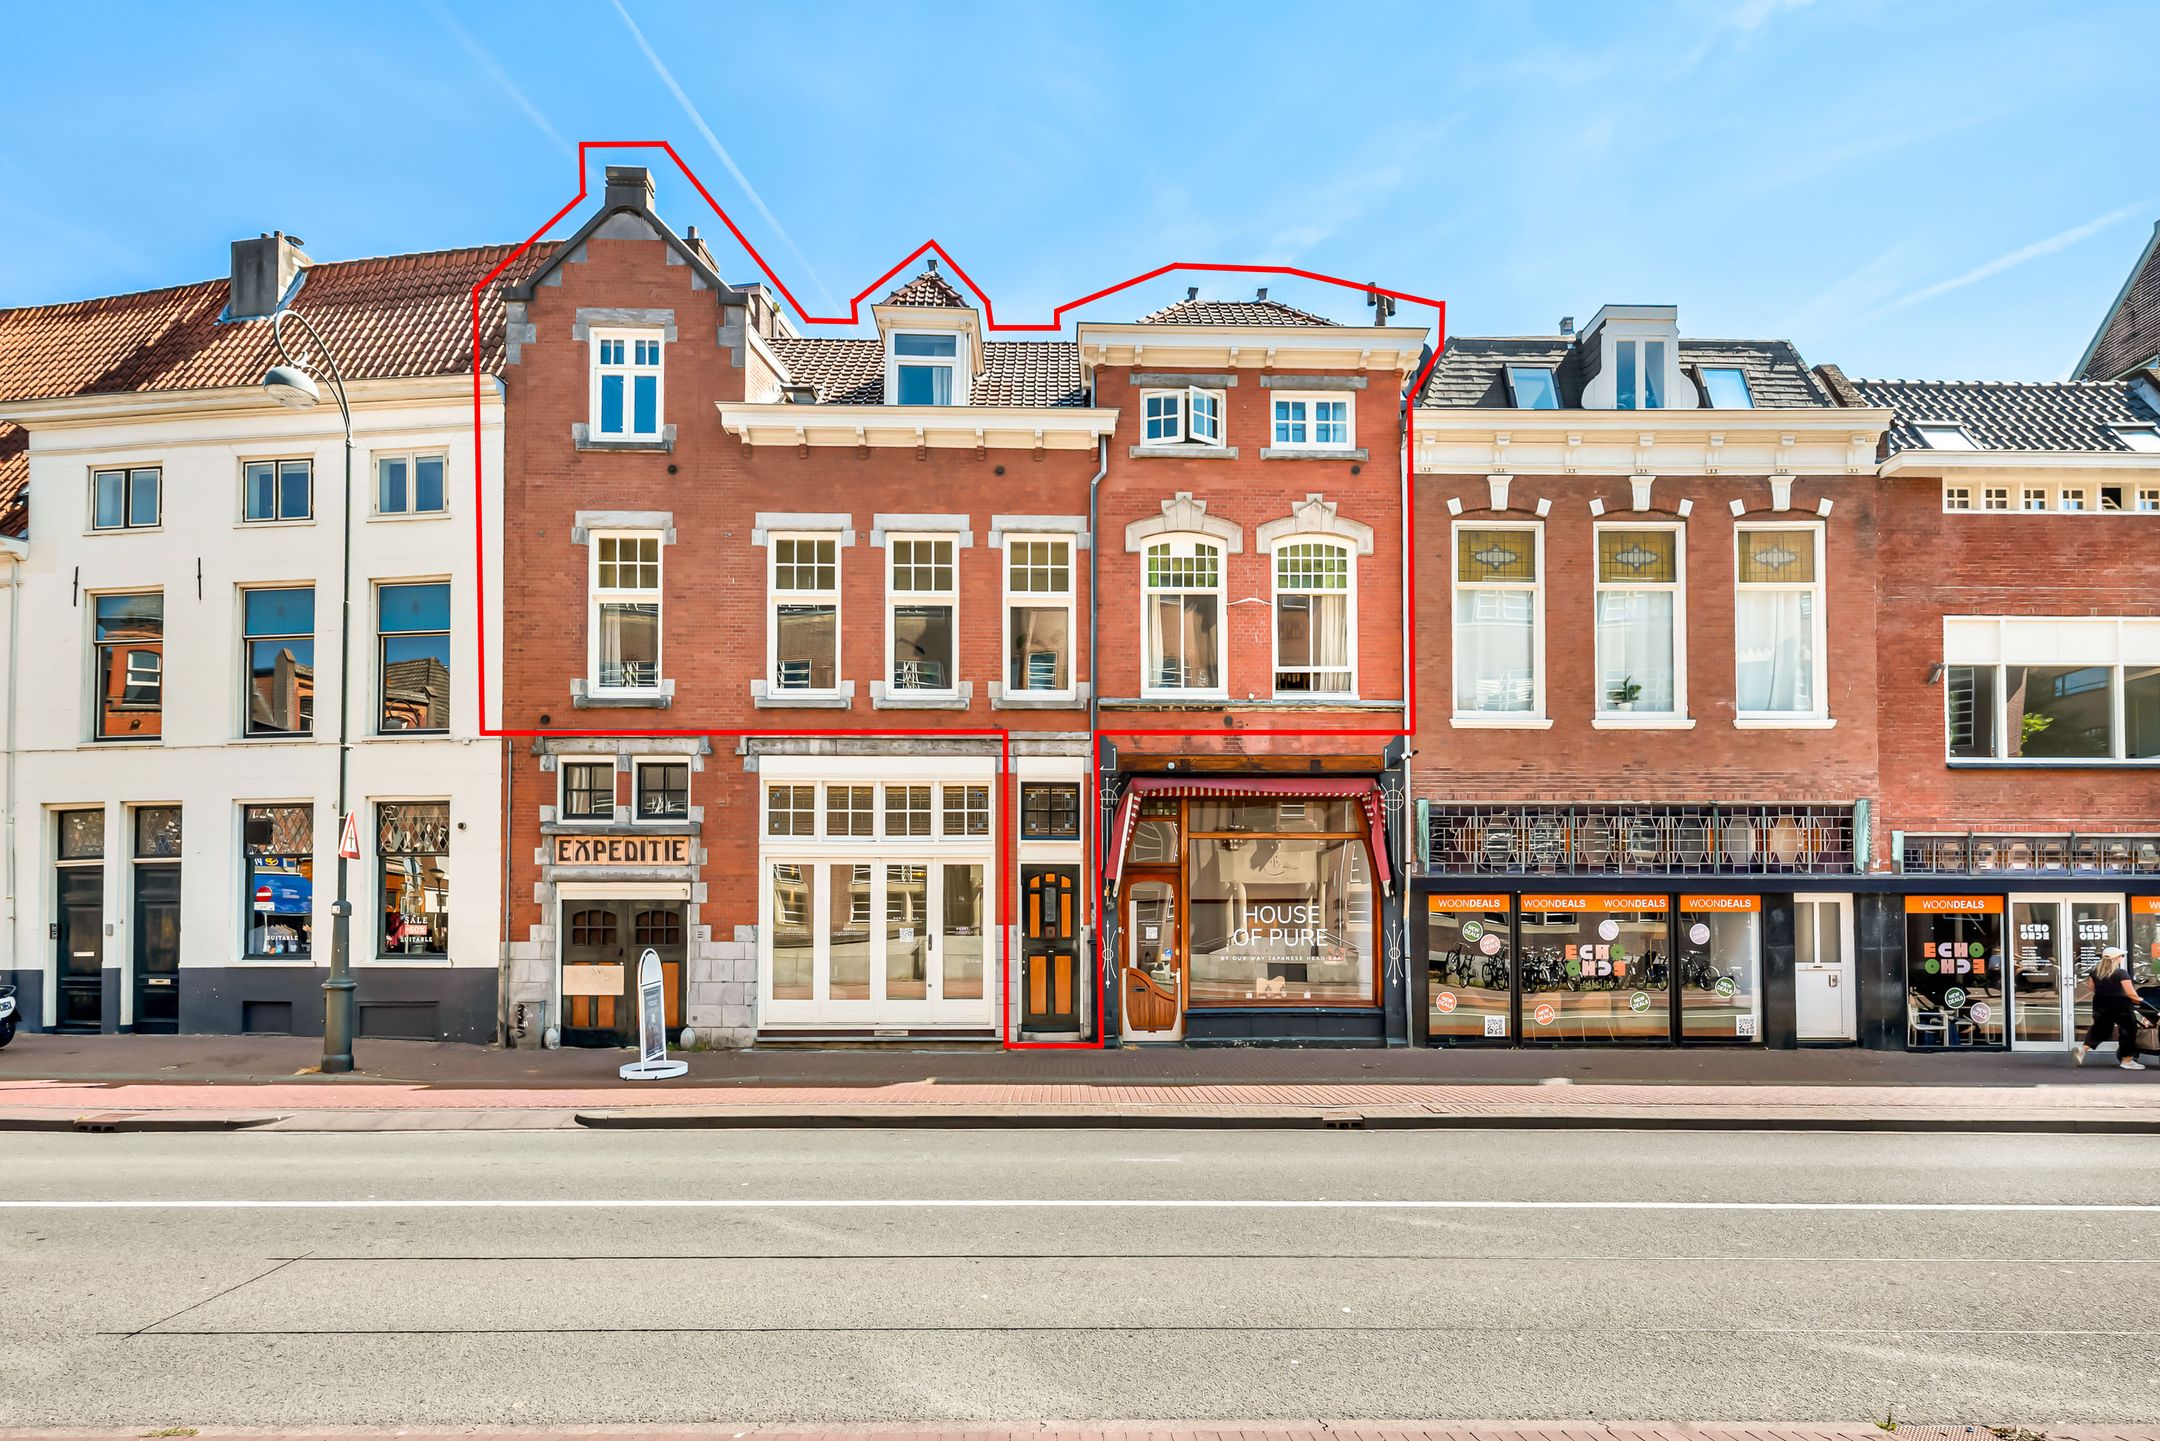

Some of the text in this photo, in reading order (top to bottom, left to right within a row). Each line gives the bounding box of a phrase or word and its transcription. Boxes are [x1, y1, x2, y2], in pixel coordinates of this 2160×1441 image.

[558, 839, 686, 862] EXPEDITIE
[1438, 899, 1501, 908] WOONDEALS
[1524, 899, 1587, 908] WOONDEALS
[1603, 899, 1666, 908] WOONDEALS
[1689, 899, 1752, 908] WOONDEALS
[1922, 899, 1985, 909] WOONDEALS
[1242, 905, 1321, 924] HOUSE
[404, 916, 429, 924] SALE
[2020, 923, 2050, 932] ECHO
[2079, 924, 2109, 933] ECHO
[1233, 928, 1328, 947] OF PURE
[1464, 929, 1480, 939] DEALS
[1564, 943, 1626, 960] ECHO
[1923, 941, 1985, 958] ECHO
[1717, 984, 1733, 995] DEALS
[1438, 999, 1454, 1010] DEALS
[1633, 999, 1649, 1009] DEALS
[1948, 996, 1964, 1005] DEALS
[1537, 1012, 1553, 1022] DEALS
